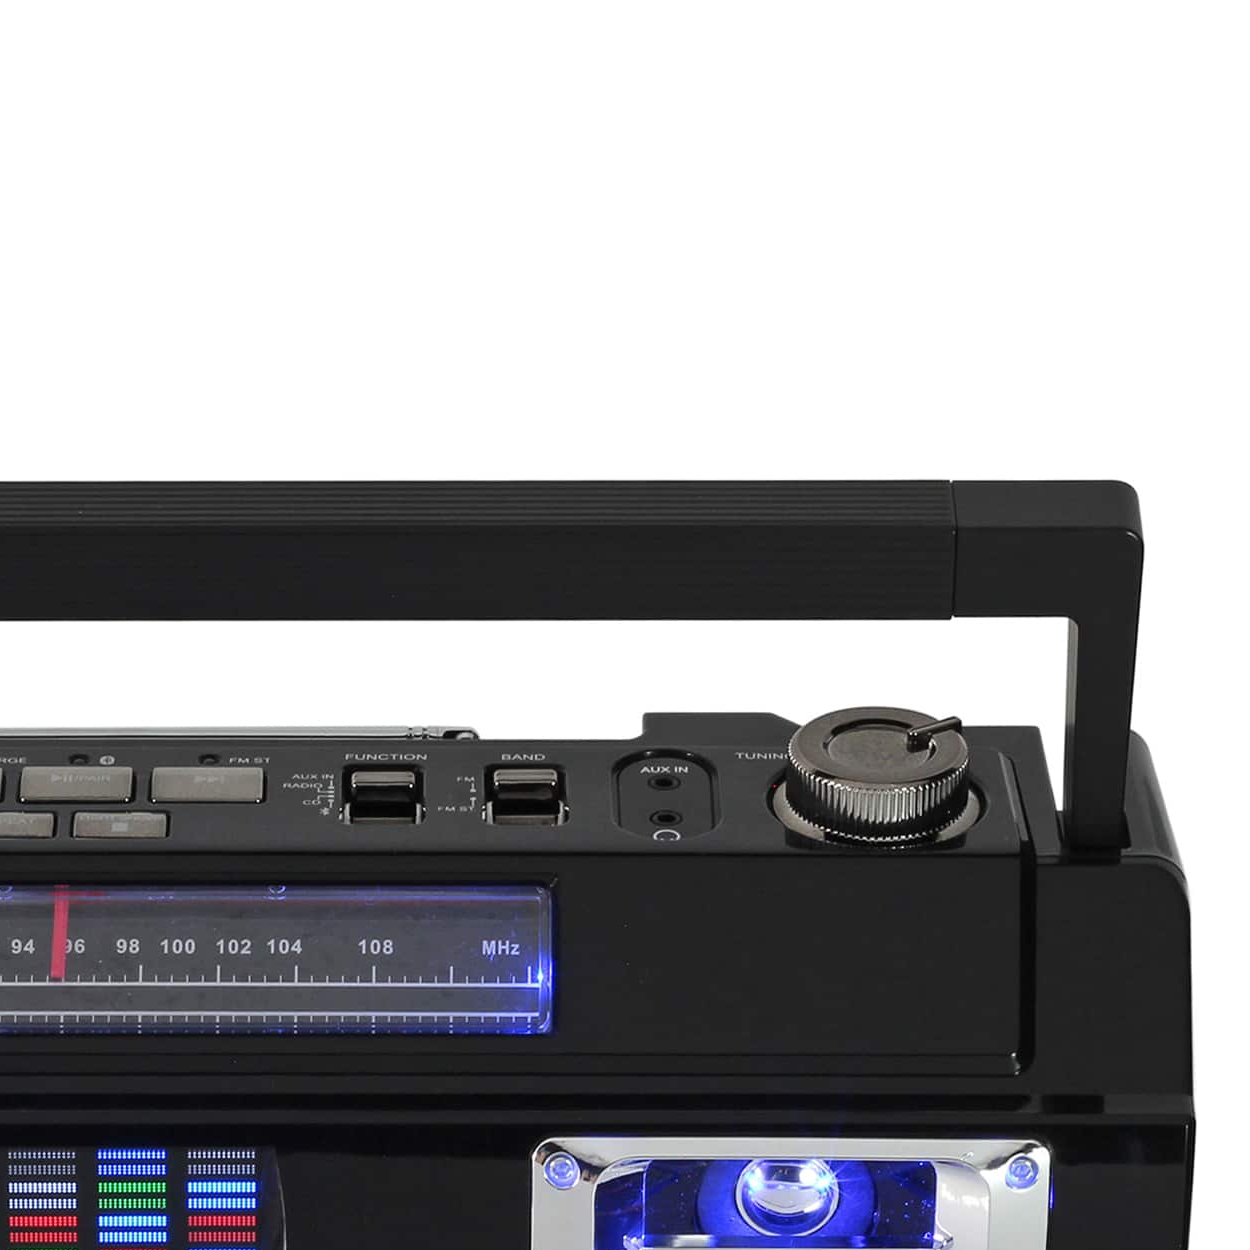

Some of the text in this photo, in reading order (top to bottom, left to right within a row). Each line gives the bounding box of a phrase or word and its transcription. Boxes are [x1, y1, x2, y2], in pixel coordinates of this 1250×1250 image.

[345, 753, 427, 761] FUNCTION
[501, 753, 546, 761] BAND
[640, 766, 688, 774] AUX IN
[11, 939, 35, 954] 94
[116, 939, 140, 954] 98
[160, 939, 196, 954] 100
[216, 939, 251, 954] 102
[266, 939, 302, 954] 104
[358, 939, 394, 954] 108
[482, 940, 520, 956] MHz
